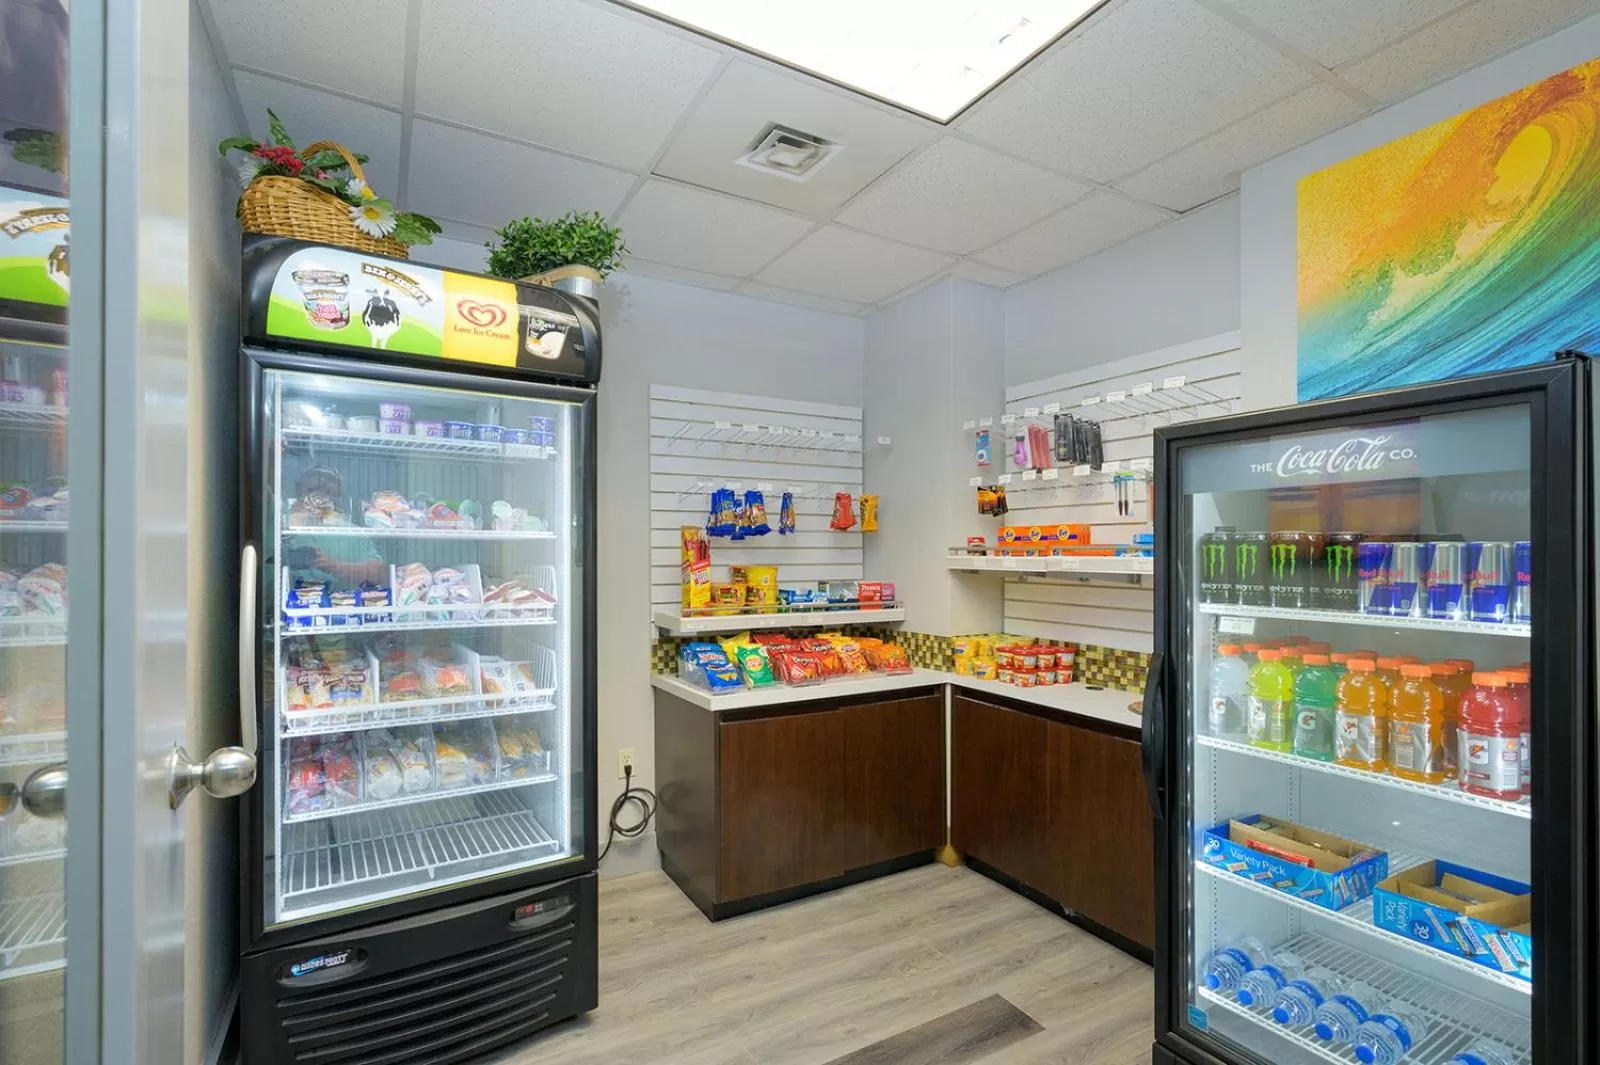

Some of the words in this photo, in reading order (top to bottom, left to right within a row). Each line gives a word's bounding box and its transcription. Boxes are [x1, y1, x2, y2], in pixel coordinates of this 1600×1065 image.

[454, 323, 473, 333] Love
[473, 327, 486, 336] Ice
[486, 328, 511, 341] Cream
[1250, 462, 1273, 474] THE
[1390, 448, 1417, 461] CO.
[1208, 837, 1220, 848] 30
[1230, 847, 1261, 869] Variety
[1262, 860, 1286, 876] Pack
[1385, 901, 1397, 922] Pack
